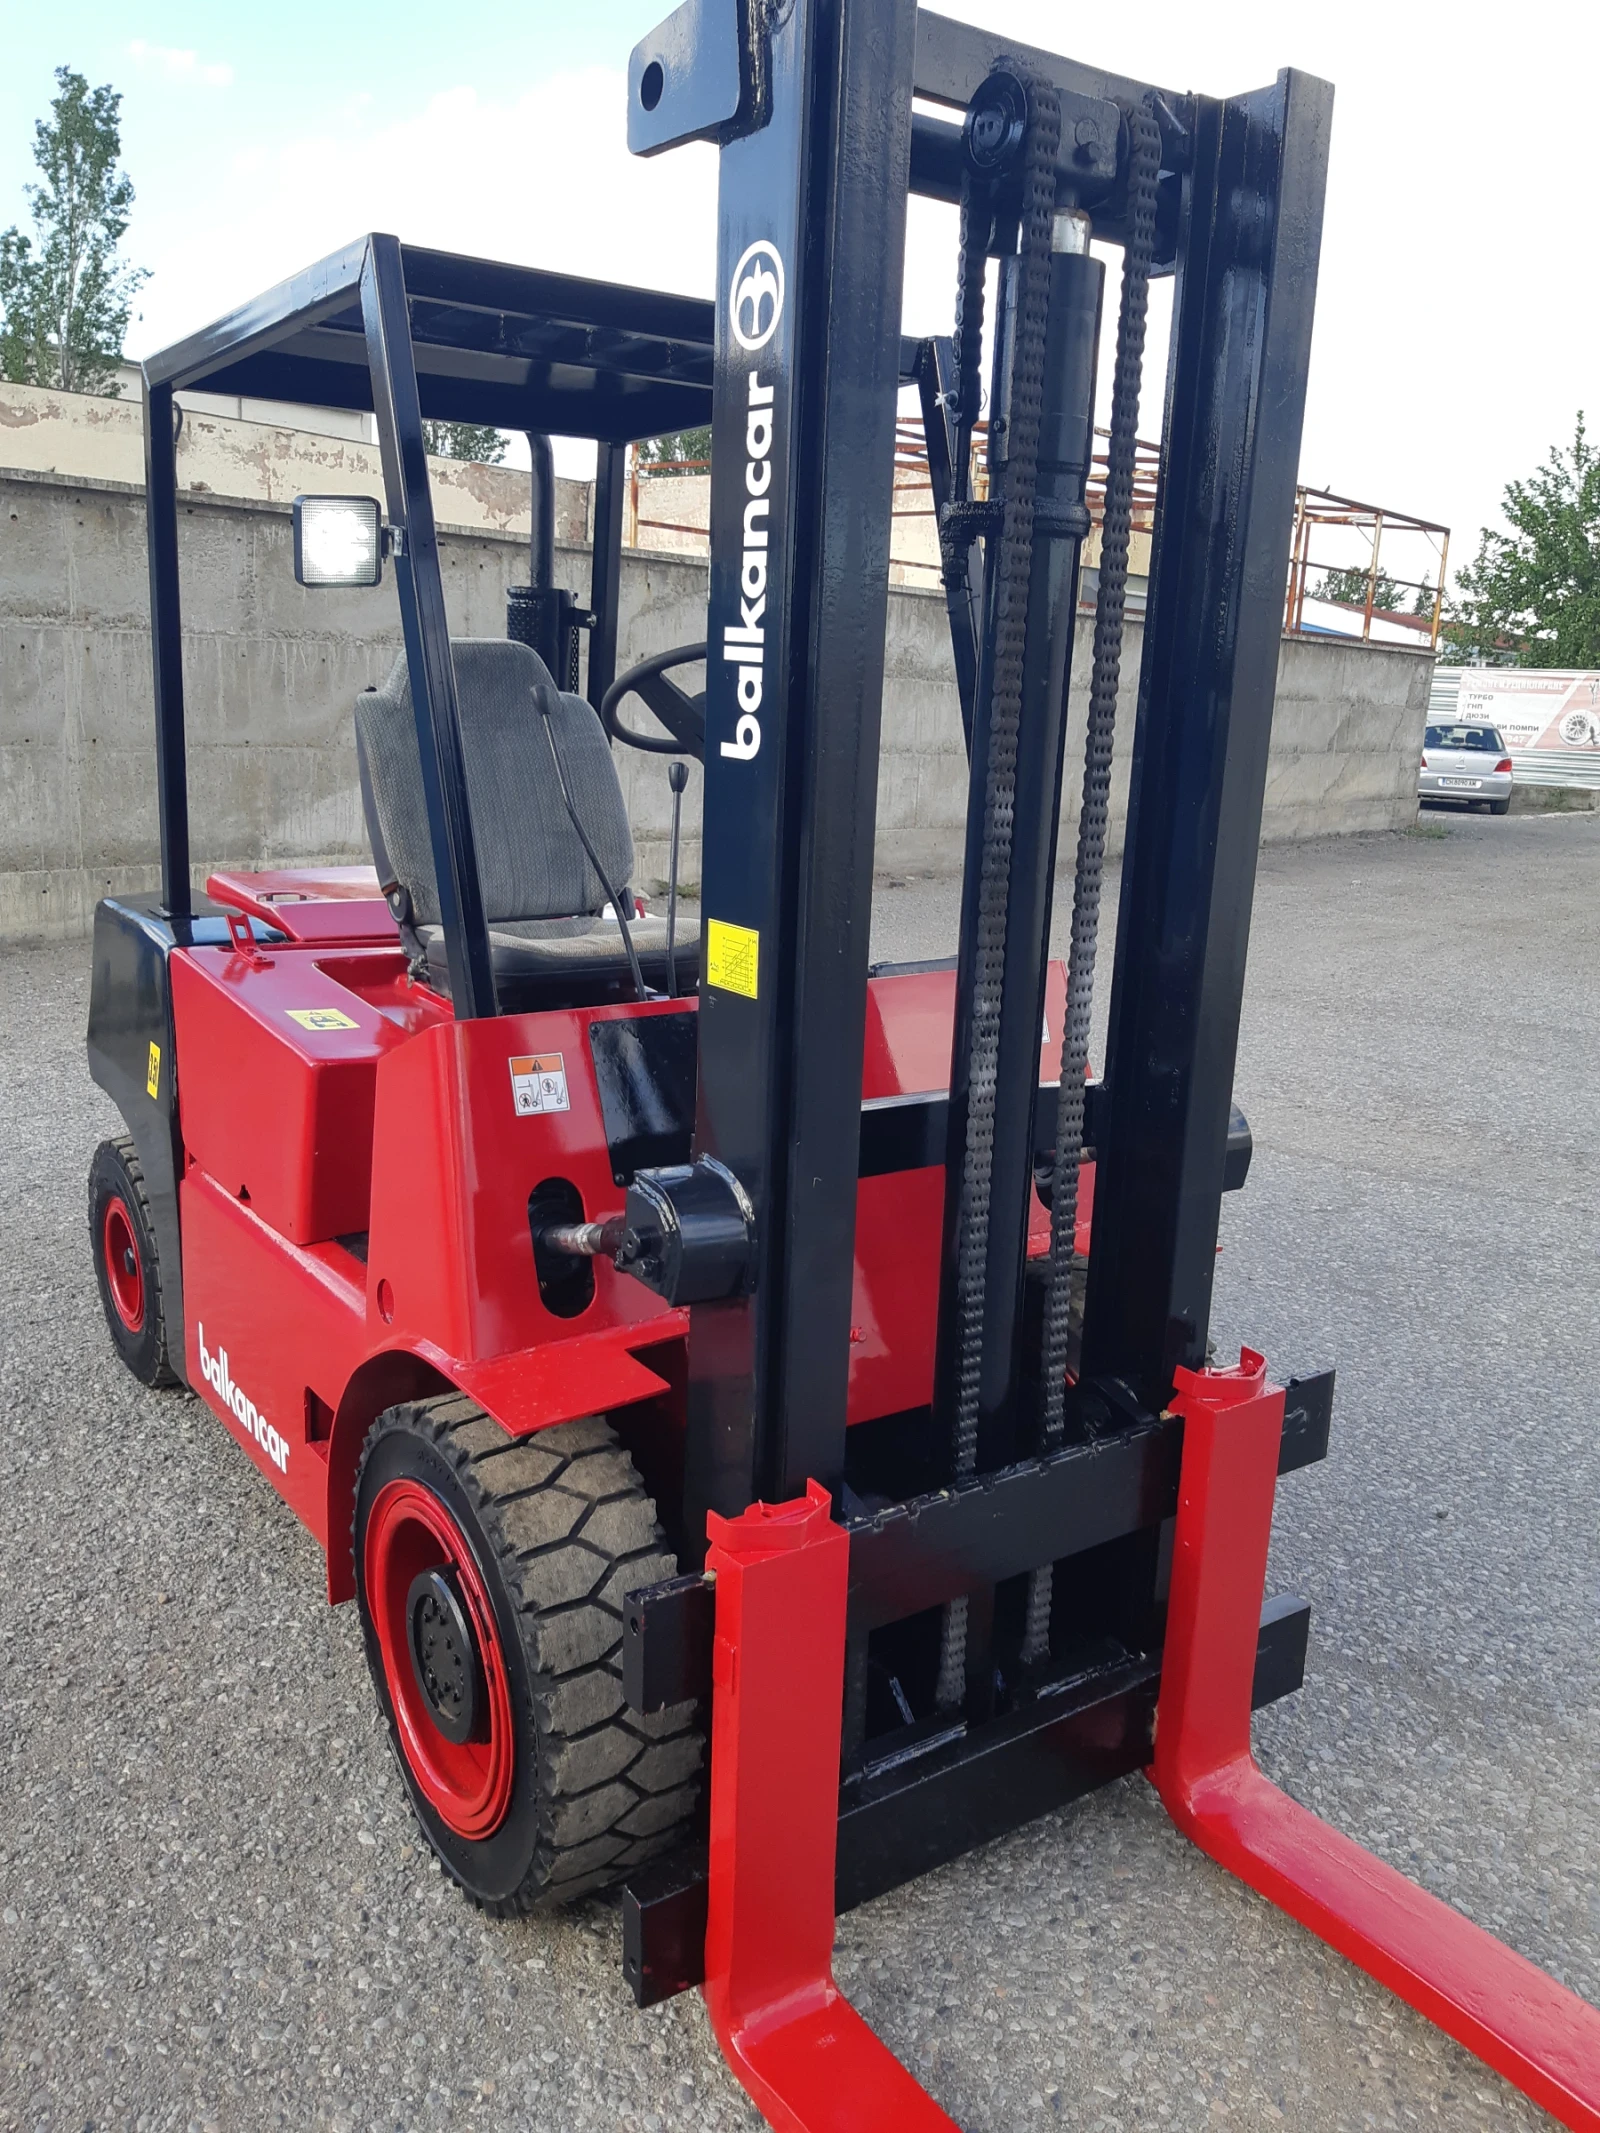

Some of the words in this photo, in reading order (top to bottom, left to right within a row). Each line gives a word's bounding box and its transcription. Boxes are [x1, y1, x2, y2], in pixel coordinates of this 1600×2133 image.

[720, 371, 774, 761] balkancar
[1468, 693, 1494, 701] ТУРБО
[1465, 712, 1490, 720] ДЮЗИ
[1509, 724, 1539, 732] ПОМПИ
[198, 1320, 290, 1474] balkancar
